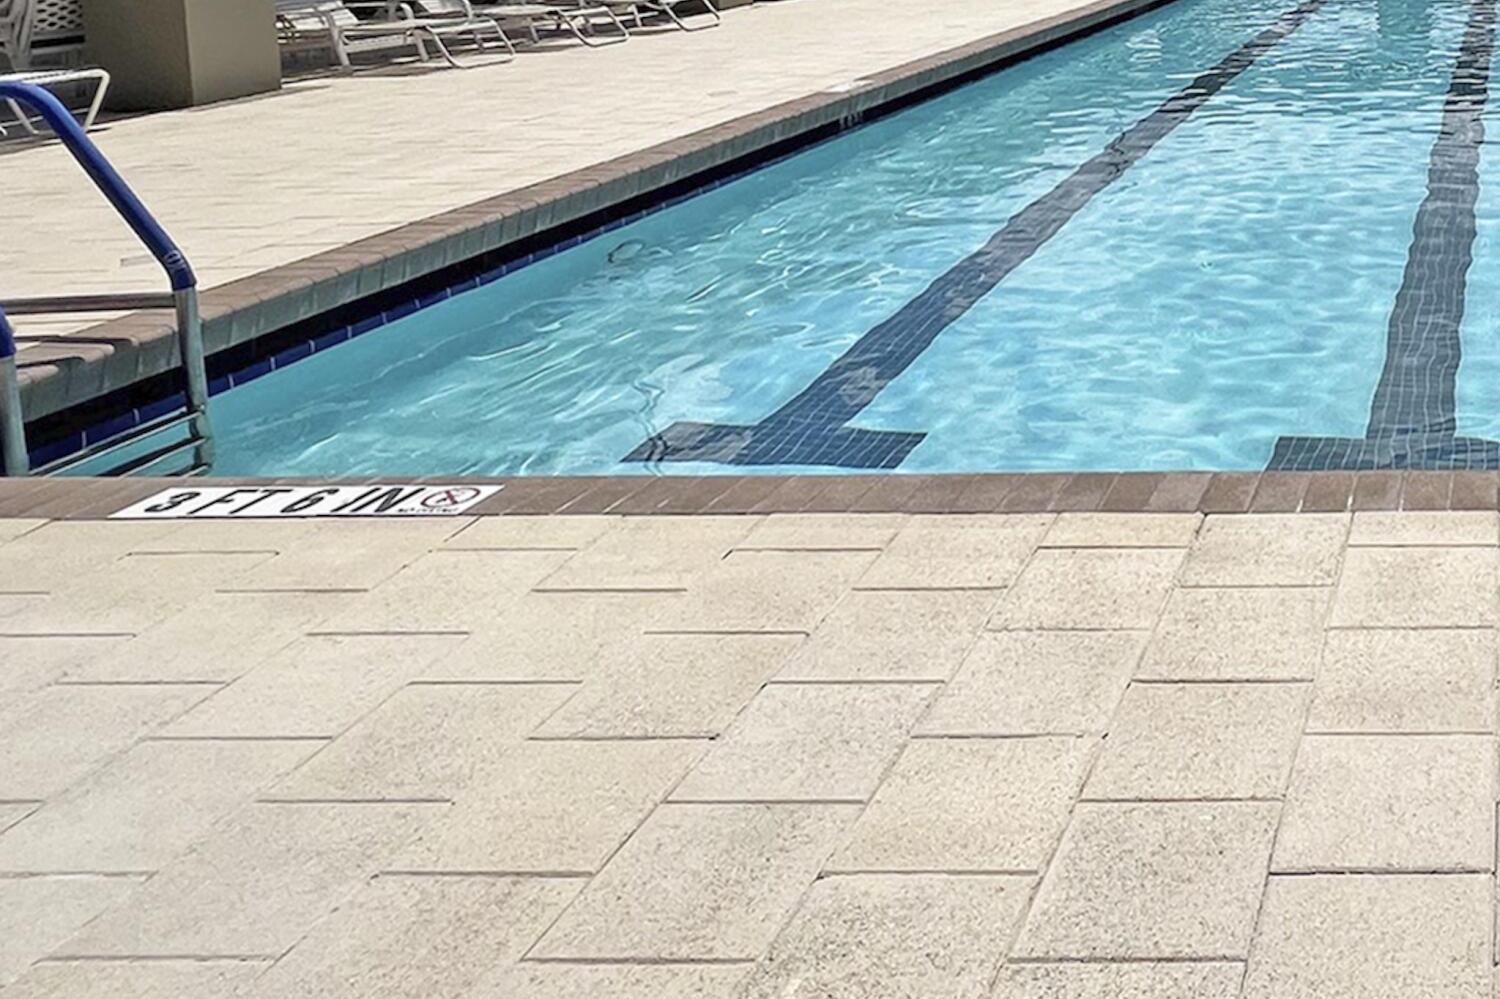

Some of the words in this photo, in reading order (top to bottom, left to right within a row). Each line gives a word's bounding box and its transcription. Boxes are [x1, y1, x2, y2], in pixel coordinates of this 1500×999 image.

[144, 491, 201, 512] 3
[187, 488, 293, 514] FT
[280, 487, 340, 513] 6
[330, 487, 426, 513] IN
